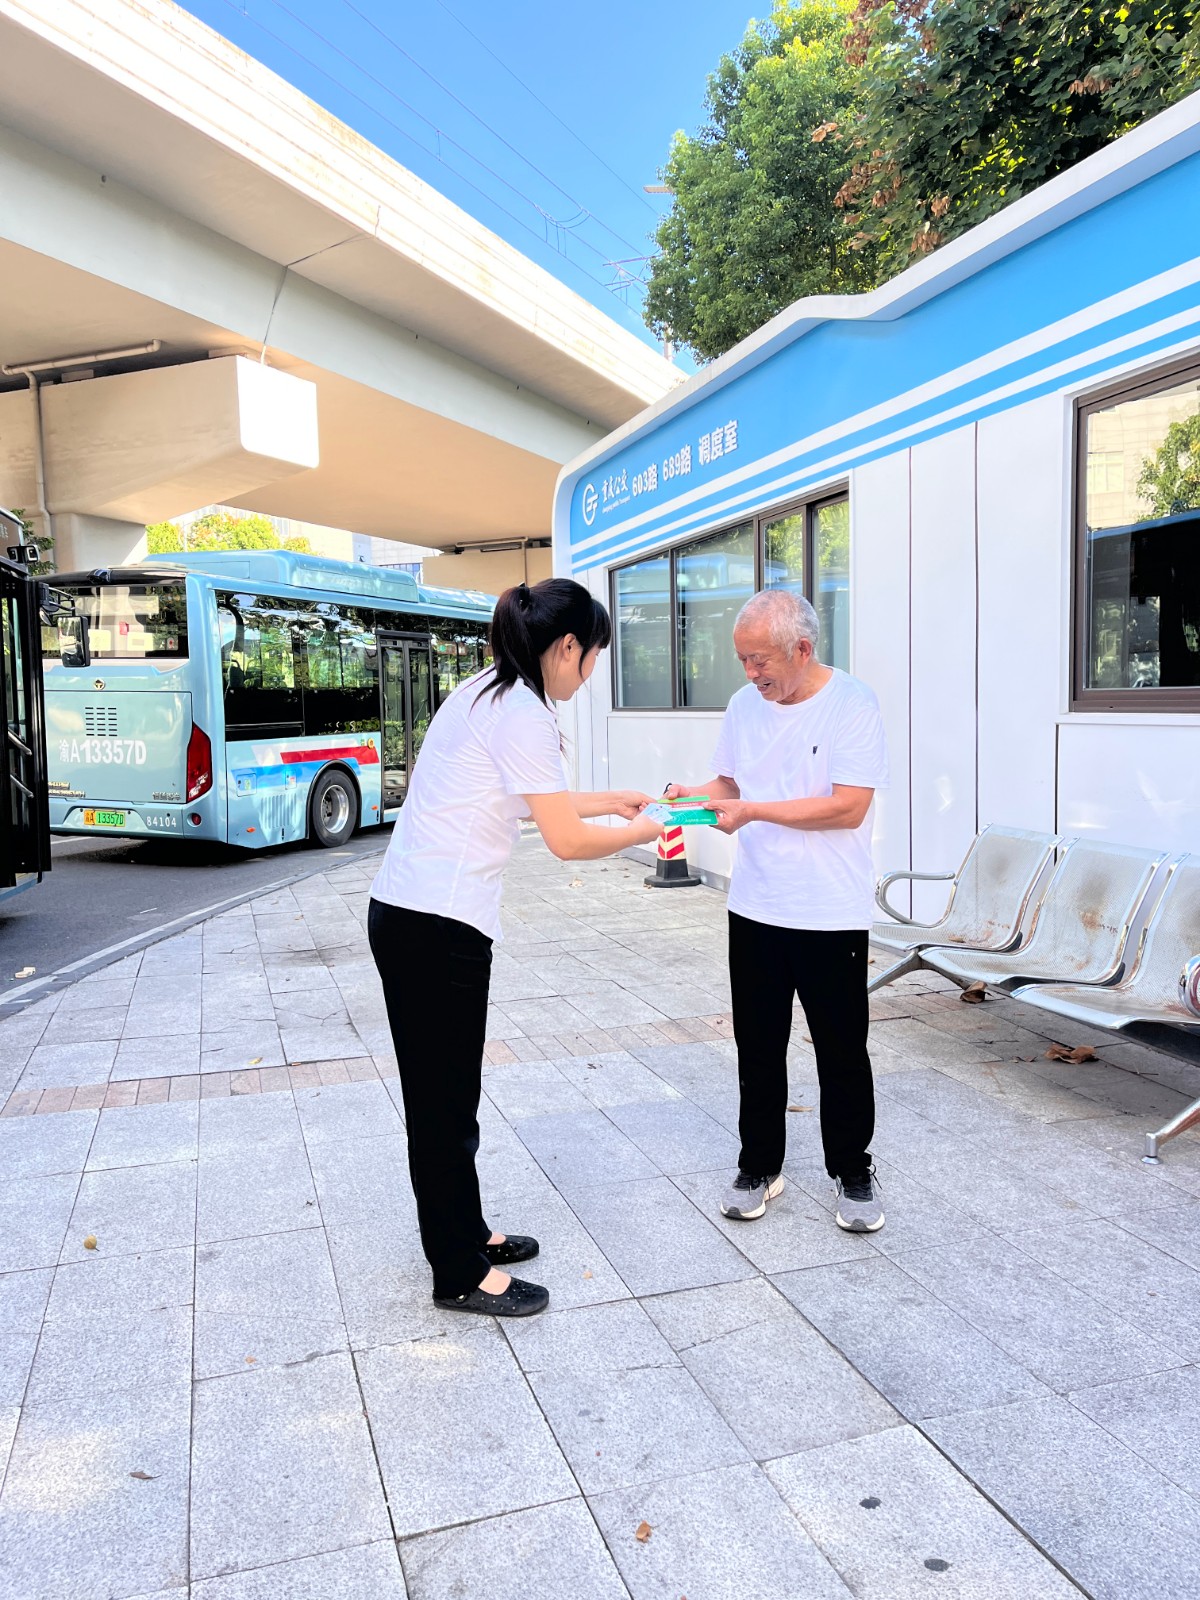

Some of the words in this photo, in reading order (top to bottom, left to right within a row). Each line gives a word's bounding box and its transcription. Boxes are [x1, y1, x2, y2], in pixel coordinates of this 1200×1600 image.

[632, 463, 658, 497] 603路
[662, 444, 692, 481] 689路
[698, 419, 739, 465] 调度室
[59, 739, 147, 765] 渝A13357D
[146, 816, 177, 828] 84104
